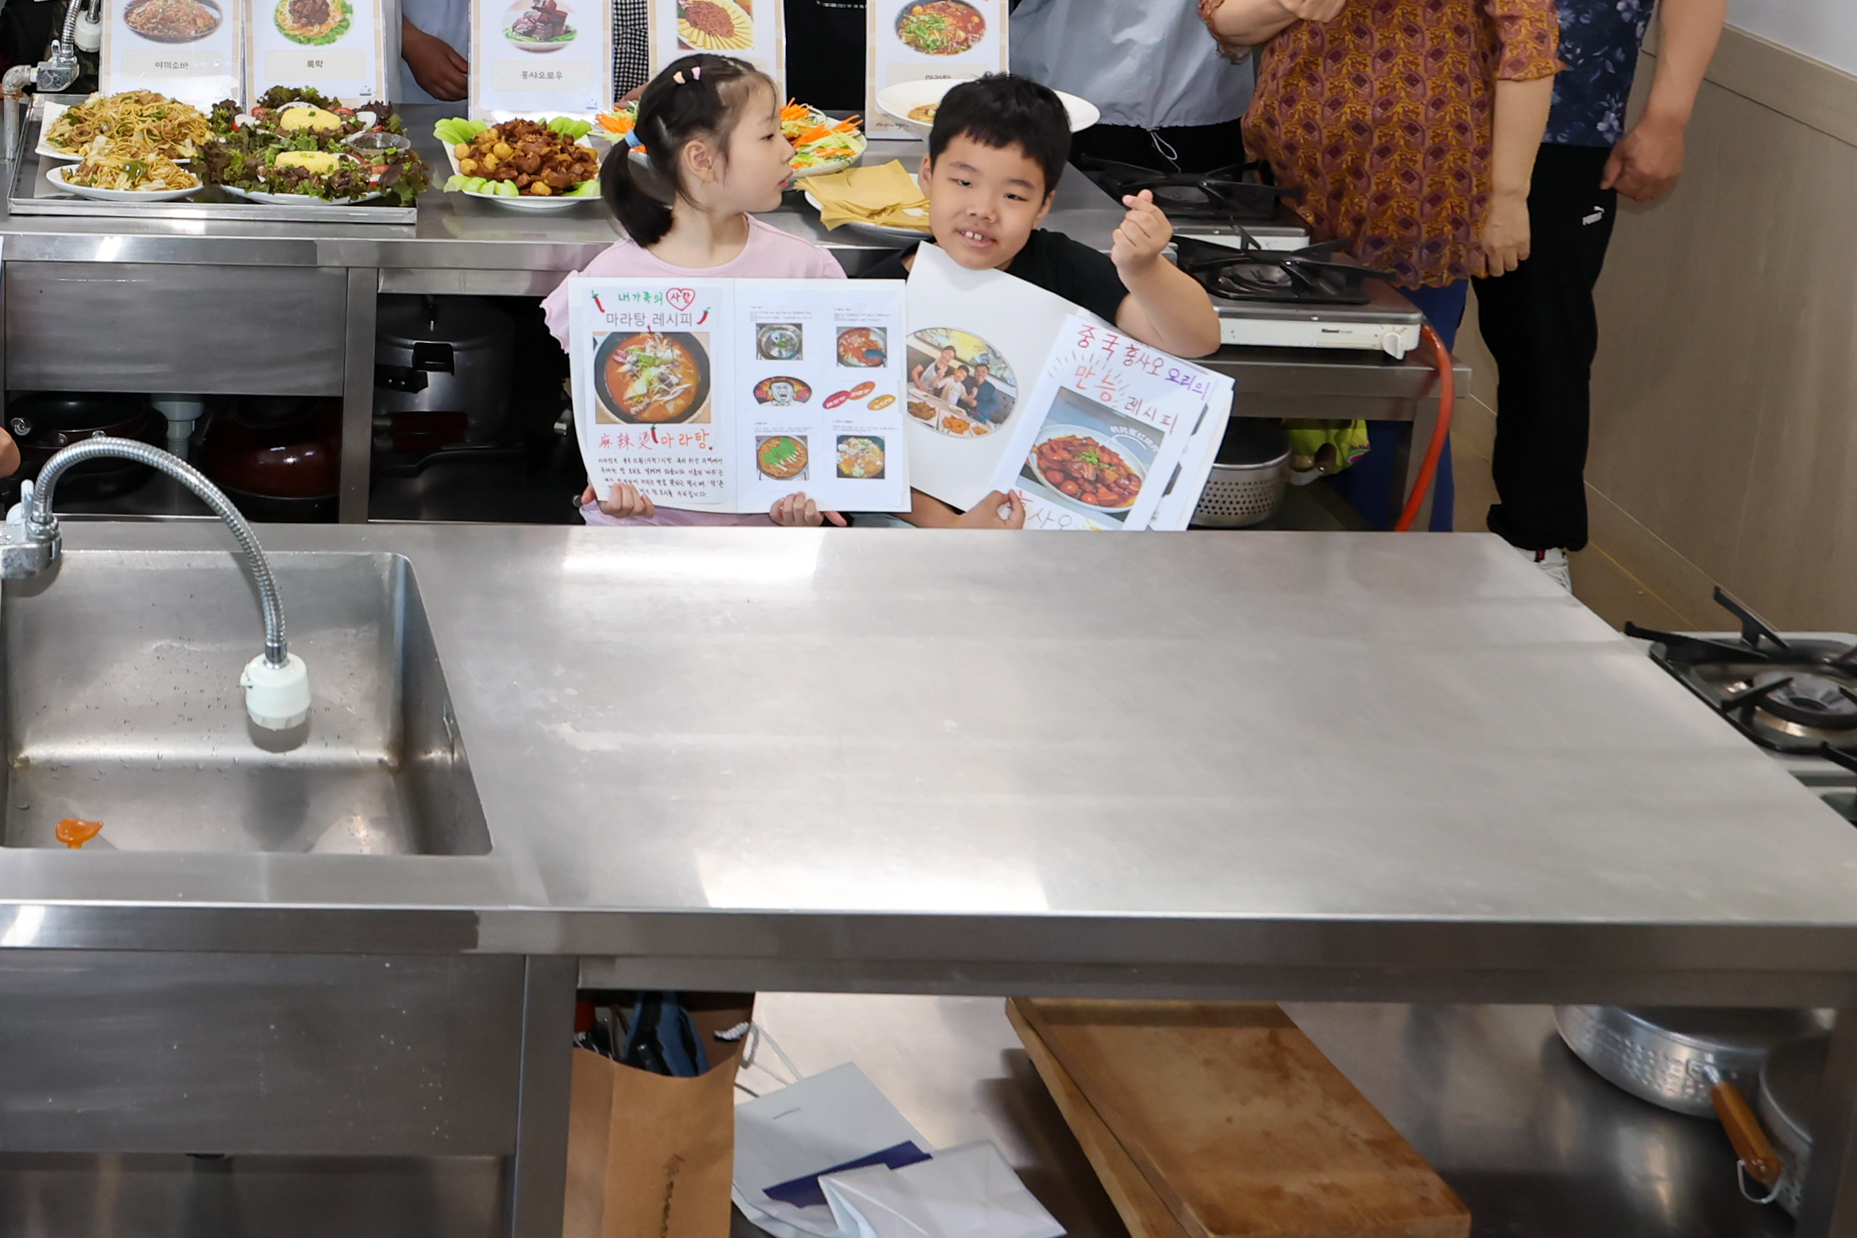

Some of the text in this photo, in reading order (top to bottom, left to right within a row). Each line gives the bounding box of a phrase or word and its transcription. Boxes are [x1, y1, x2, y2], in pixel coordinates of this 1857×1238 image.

[671, 291, 691, 304] 사랑
[606, 312, 693, 327] 마라탕 레시피
[1077, 324, 1120, 361] 중국
[1075, 365, 1117, 402] 만능
[1124, 395, 1179, 435] 레시피
[661, 428, 710, 449] 마라탕
